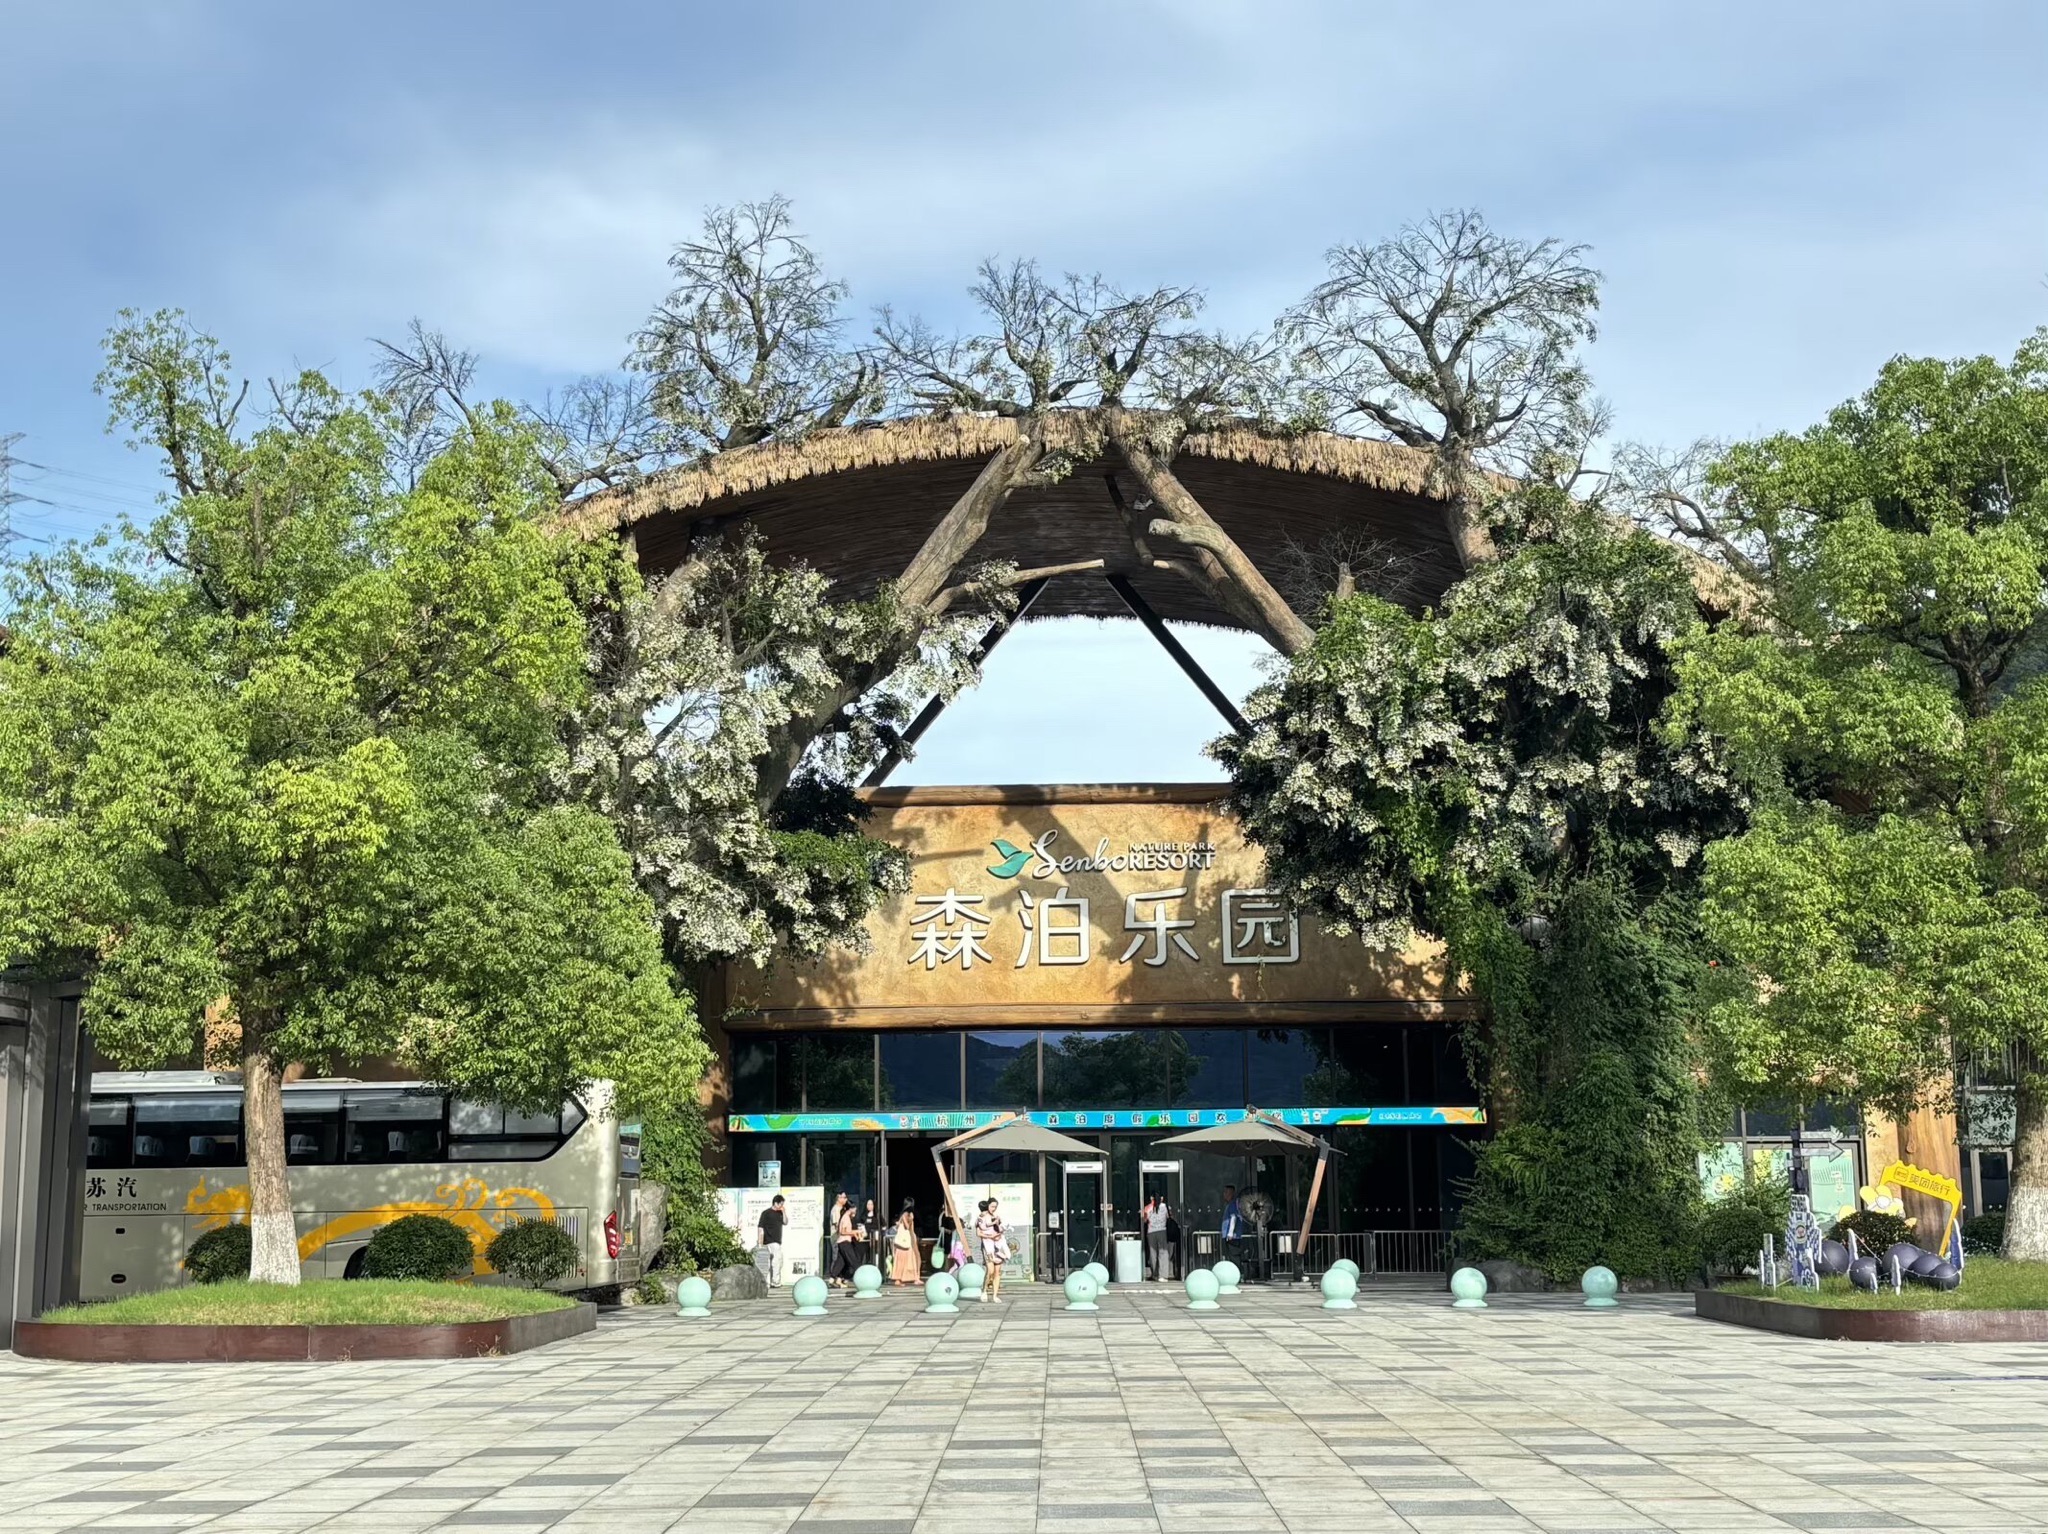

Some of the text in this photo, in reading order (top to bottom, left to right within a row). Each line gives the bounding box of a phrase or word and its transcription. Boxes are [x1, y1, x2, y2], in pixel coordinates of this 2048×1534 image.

[1031, 829, 1127, 879] Senbo
[1128, 842, 1215, 852] NATURE PARK
[1128, 852, 1215, 870] RESORT
[908, 887, 1300, 970] 森泊乐园
[86, 1177, 137, 1198] 苏汽
[1909, 1173, 1951, 1196] 美团旅行
[92, 1203, 167, 1212] TRANSPORTATION
